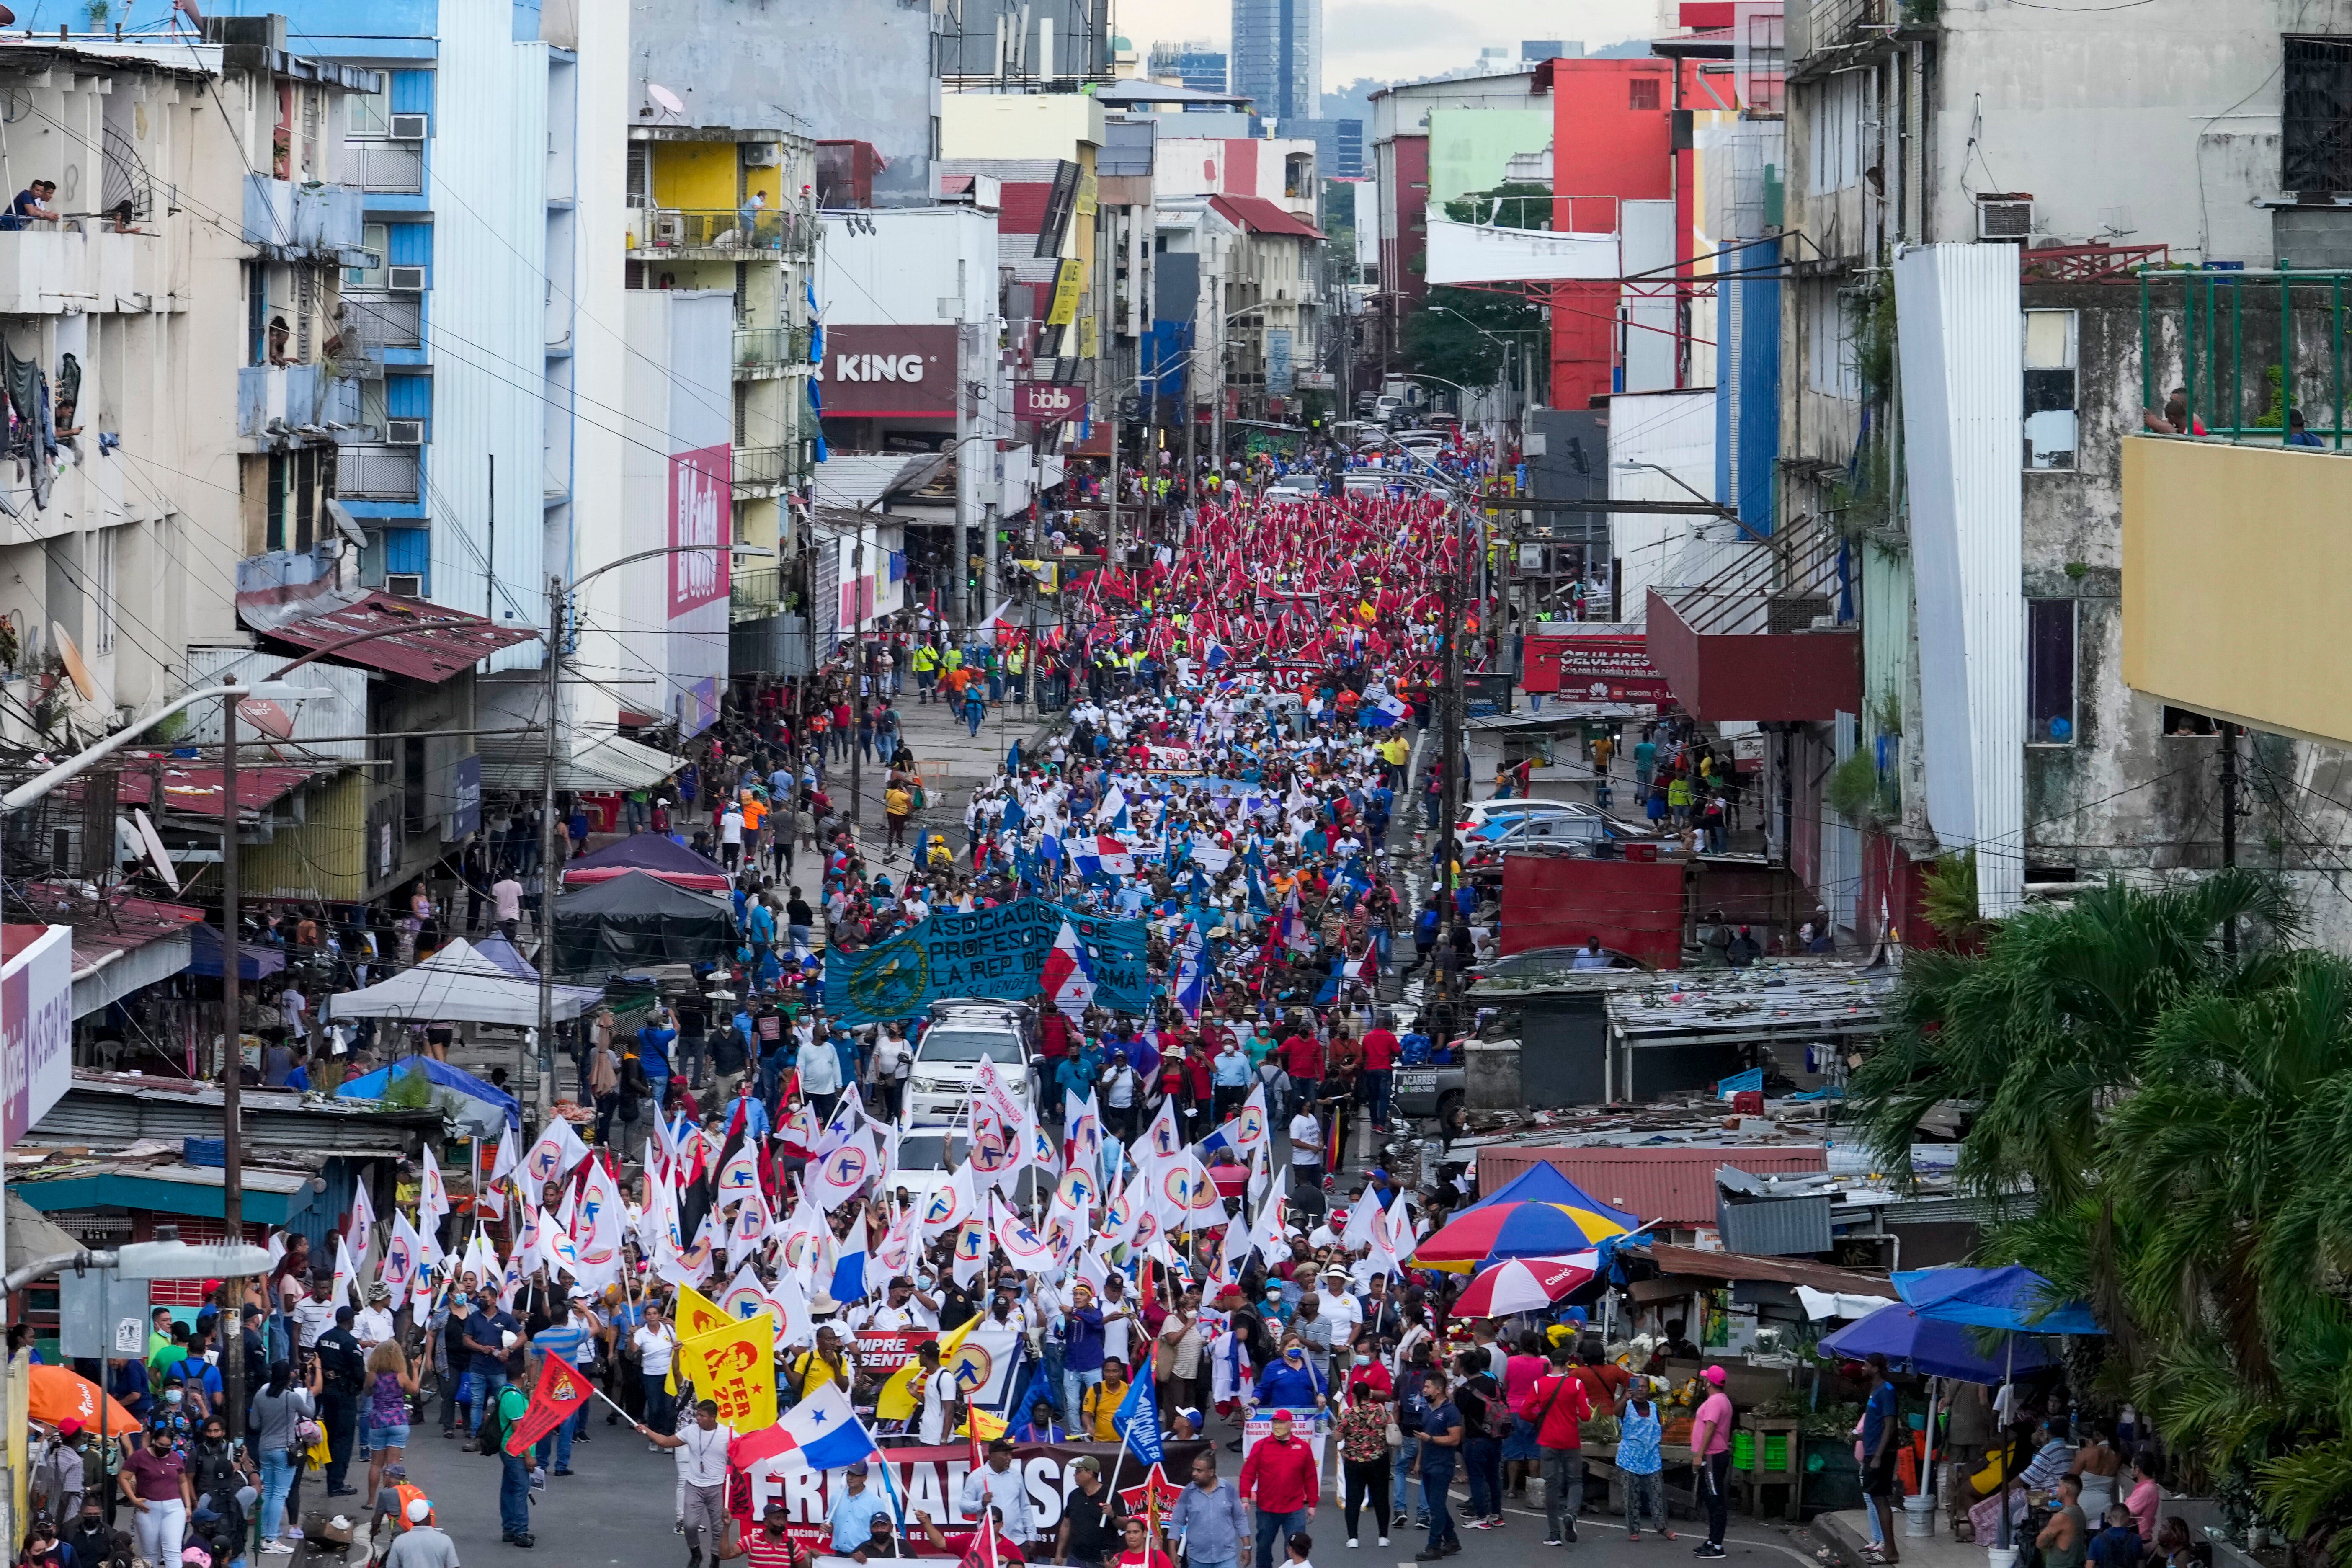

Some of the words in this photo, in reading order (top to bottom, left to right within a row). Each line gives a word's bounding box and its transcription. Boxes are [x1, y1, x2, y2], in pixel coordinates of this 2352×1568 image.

[837, 354, 923, 382] KING
[1029, 388, 1070, 409] bbb
[1560, 650, 1651, 667] CELULARES
[1079, 920, 1111, 941] DE
[1086, 942, 1117, 964] DE
[931, 965, 963, 987] LA
[1022, 948, 1045, 972] DE
[967, 983, 982, 998] SE
[989, 976, 1027, 995] VENDE
[3, 1017, 26, 1120] Digital
[1402, 1075, 1437, 1086] ACARREO
[1545, 1269, 1571, 1285] Claro
[713, 1387, 734, 1419] 29
[729, 1377, 750, 1418] FER
[910, 1532, 922, 1540] DE
